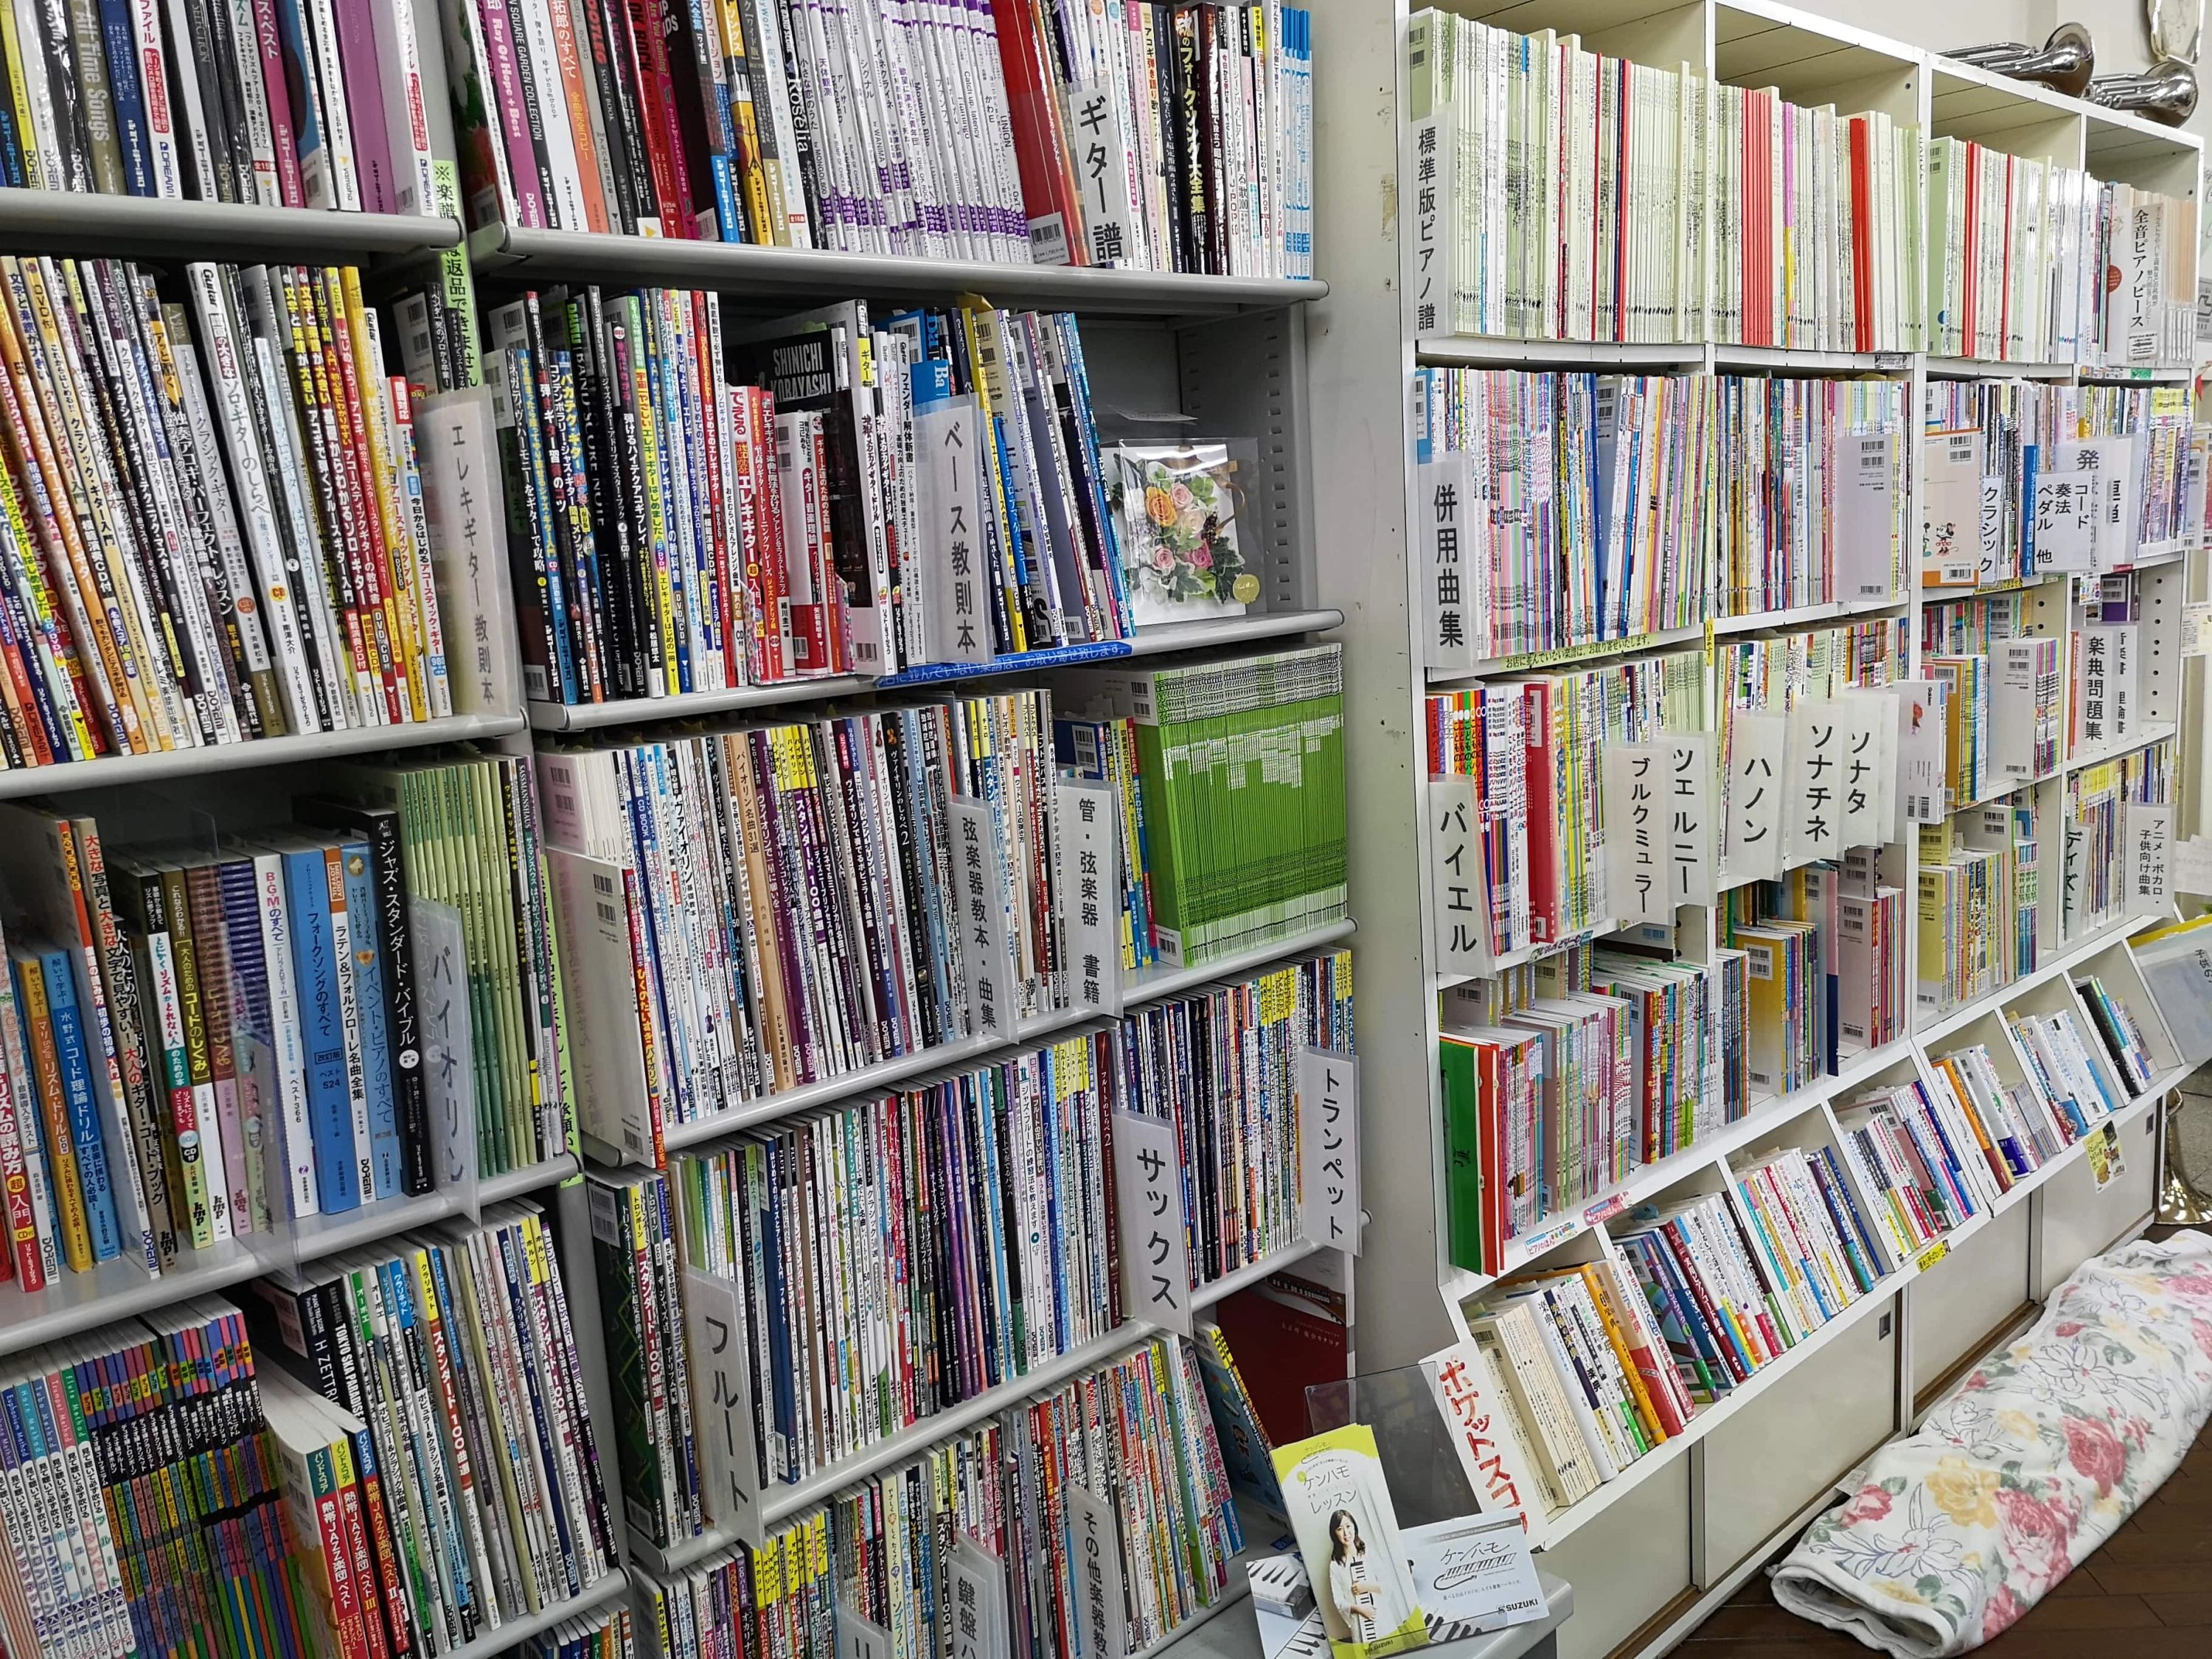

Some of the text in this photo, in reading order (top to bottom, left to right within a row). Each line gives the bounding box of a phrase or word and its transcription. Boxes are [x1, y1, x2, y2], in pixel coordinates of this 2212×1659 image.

[86, 88, 110, 142] Songs
[492, 18, 503, 46] Ray
[509, 108, 522, 138] Best
[509, 7, 543, 141] SQUARE GARDEN COLLECTION
[800, 58, 818, 130] 小さな恋のうた
[818, 58, 832, 96] 天体観測
[1000, 115, 1012, 148] UNION
[1080, 95, 1123, 260] ギター譜
[1417, 125, 1437, 332] 標準版ピアノ譜
[2130, 209, 2149, 328] 全音ピアノピース
[770, 372, 832, 404] KOBAYASHI
[773, 341, 824, 377] SHINICHI
[224, 378, 273, 515] ソロ・ギターのしらべ
[731, 392, 745, 436] できる
[900, 372, 915, 464] フェンダー解体新書
[71, 418, 116, 546] クラシック・ギター入門
[738, 477, 756, 563] エレキギター
[1980, 487, 1998, 573] クラシック
[2037, 484, 2053, 563] ペダル 他
[2055, 484, 2071, 514] 奏法
[2075, 484, 2090, 529] コード
[451, 425, 495, 704] エレキギター教則本
[944, 422, 975, 653] ベース教則本
[1433, 484, 1464, 647] 併用曲集
[2085, 636, 2105, 740] 楽典問題集
[736, 752, 759, 855] バイオリン名曲31選
[1743, 758, 1773, 844] ハノン
[1804, 725, 1833, 843] ソナチネ
[1847, 732, 1871, 814] ソナタ
[795, 801, 814, 871] スタンダード
[809, 874, 825, 932] 100曲選
[900, 831, 911, 846] 2
[1440, 801, 1477, 953] バイエル
[1632, 757, 1653, 914] ブルクミュラー
[2138, 830, 2151, 895] 子供向け曲集
[379, 839, 417, 1048] ジャズ・スタンダード・バイブル
[962, 818, 997, 1029] 弦楽器教本・曲集
[1079, 798, 1100, 1005] 管・弦楽器 書籍
[85, 835, 164, 1206] 大きな写真と大きな文字で見やすい! 大人のギター・コード・ブック
[307, 912, 332, 1037] フォークソングのすべて
[335, 925, 366, 1101] ラテン&フォルクローレ名曲全集
[59, 1011, 94, 1142] 水野式 コード理論ドリル
[322, 1078, 341, 1090] 524
[364, 966, 393, 1124] イベント・ピアノのすべて
[434, 945, 464, 1183] バイオリン
[44, 1065, 67, 1134] リズム・ドリル
[1020, 1085, 1037, 1229] ジャズ・フルートの練習法を教えます
[1322, 1067, 1345, 1241] トランペット
[11, 1194, 33, 1226] 入門
[526, 1237, 538, 1267] ホルン
[535, 1230, 547, 1259] ホルン
[1137, 1148, 1179, 1310] サックス
[357, 1287, 370, 1326] オーボエ
[372, 1284, 384, 1324] オーボエ
[420, 1262, 437, 1310] クラリネット
[1537, 1300, 1555, 1327] 楽典
[334, 1324, 352, 1371] TOKYO SKA
[706, 1316, 748, 1512] フルート
[1439, 1354, 1528, 1535] ポケットスコ
[334, 1440, 374, 1599] バンドスコア 熱帯JAZZ楽団 ベスト
[366, 1479, 392, 1559] 熱帯JAZZ楽団
[1302, 1465, 1351, 1491] ケンハモ
[1310, 1489, 1357, 1514] レッスン
[314, 1453, 353, 1610] バンドスコア 熱帯JAZZ楽団 ベスト
[1373, 1639, 1394, 1650] SUZUKI
[1506, 1599, 1539, 1613] SUZUKI
